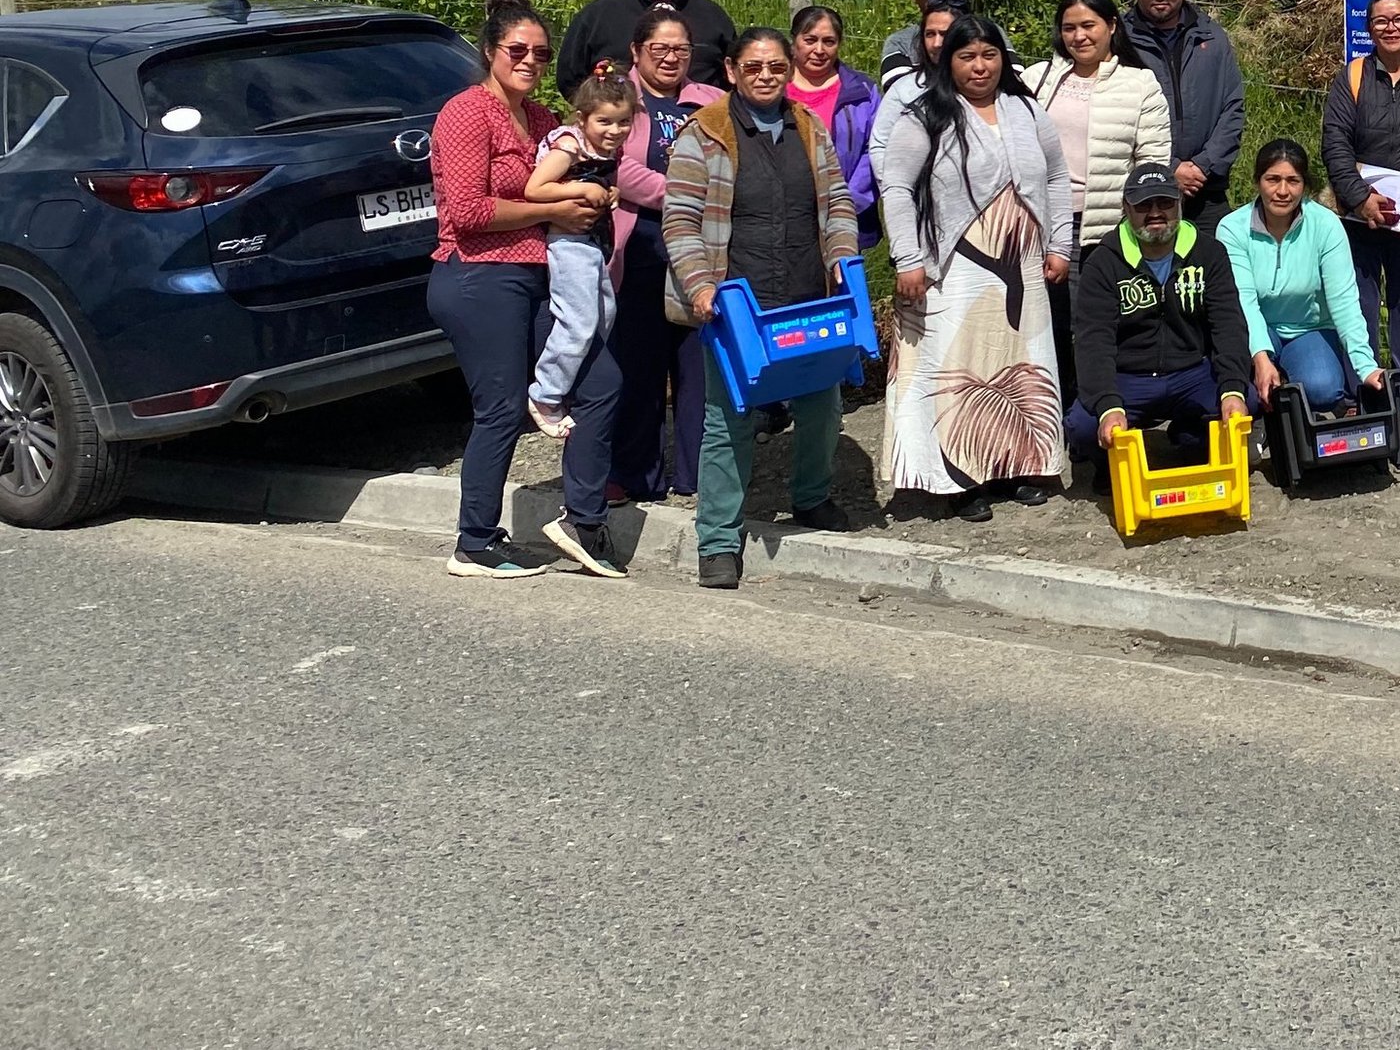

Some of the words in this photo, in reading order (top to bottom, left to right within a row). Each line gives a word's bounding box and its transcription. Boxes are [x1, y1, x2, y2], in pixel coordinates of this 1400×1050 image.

[1351, 9, 1368, 17] fond
[1351, 30, 1371, 38] Finan
[771, 318, 800, 332] papel
[801, 317, 809, 327] y
[810, 310, 845, 323] cartón
